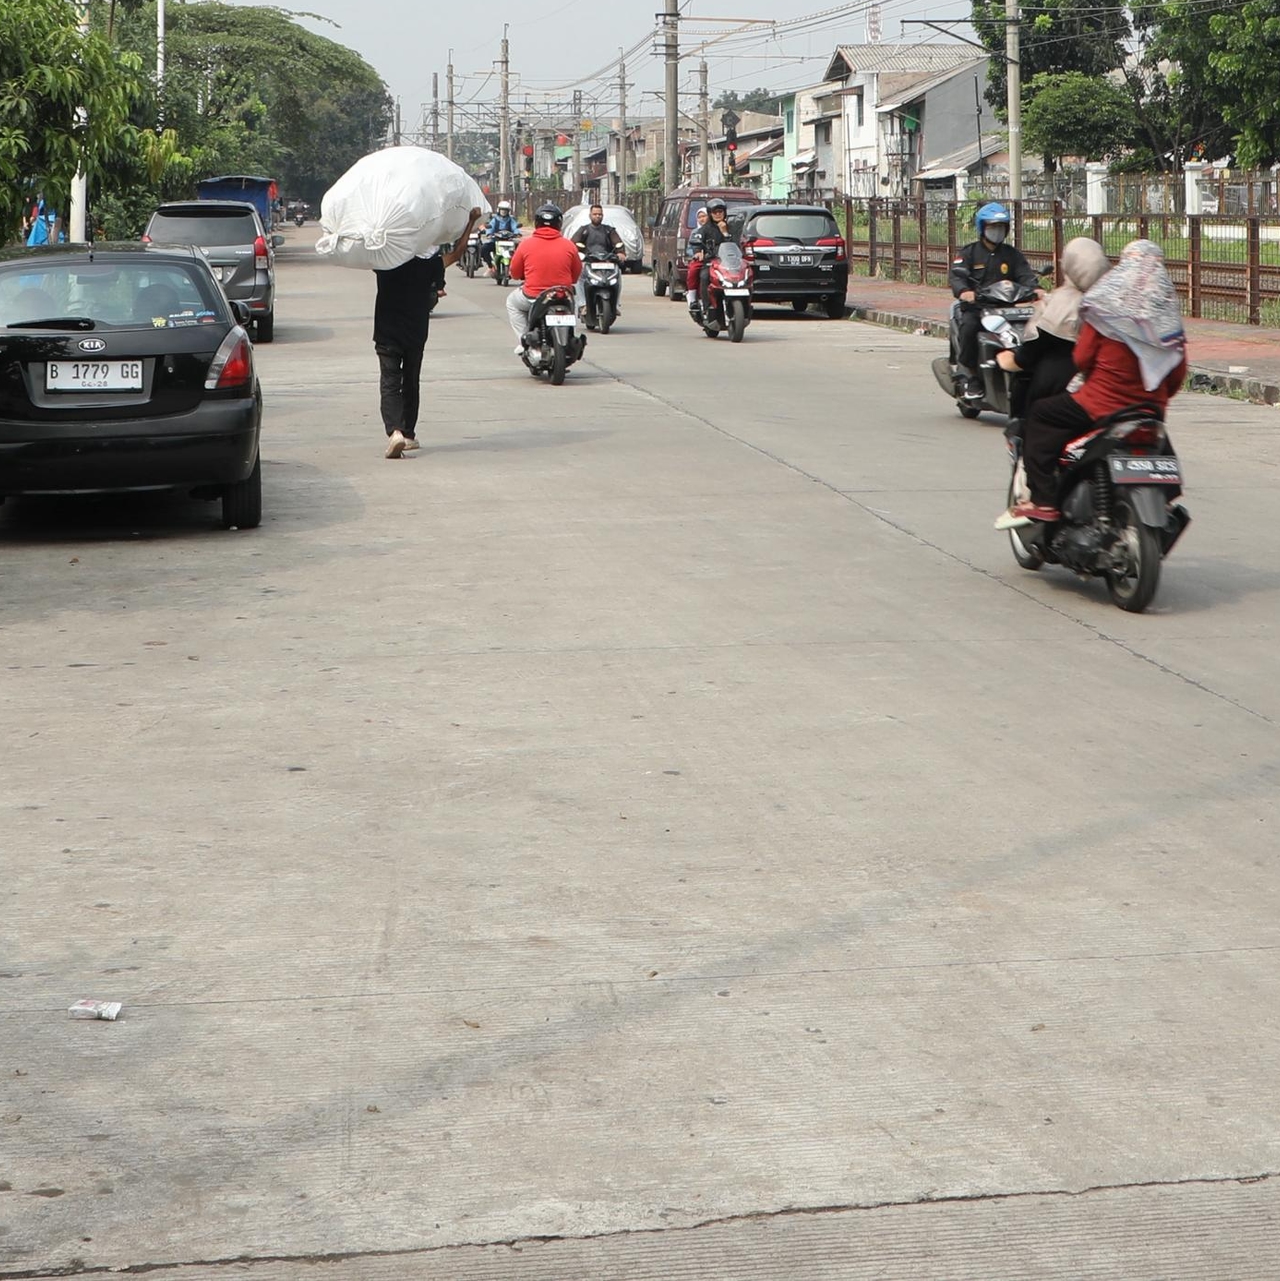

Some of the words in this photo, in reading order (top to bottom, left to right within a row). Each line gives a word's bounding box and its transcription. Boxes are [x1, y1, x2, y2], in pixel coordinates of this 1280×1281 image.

[50, 363, 59, 379] B
[72, 363, 109, 379] 1779
[121, 363, 139, 379] GG
